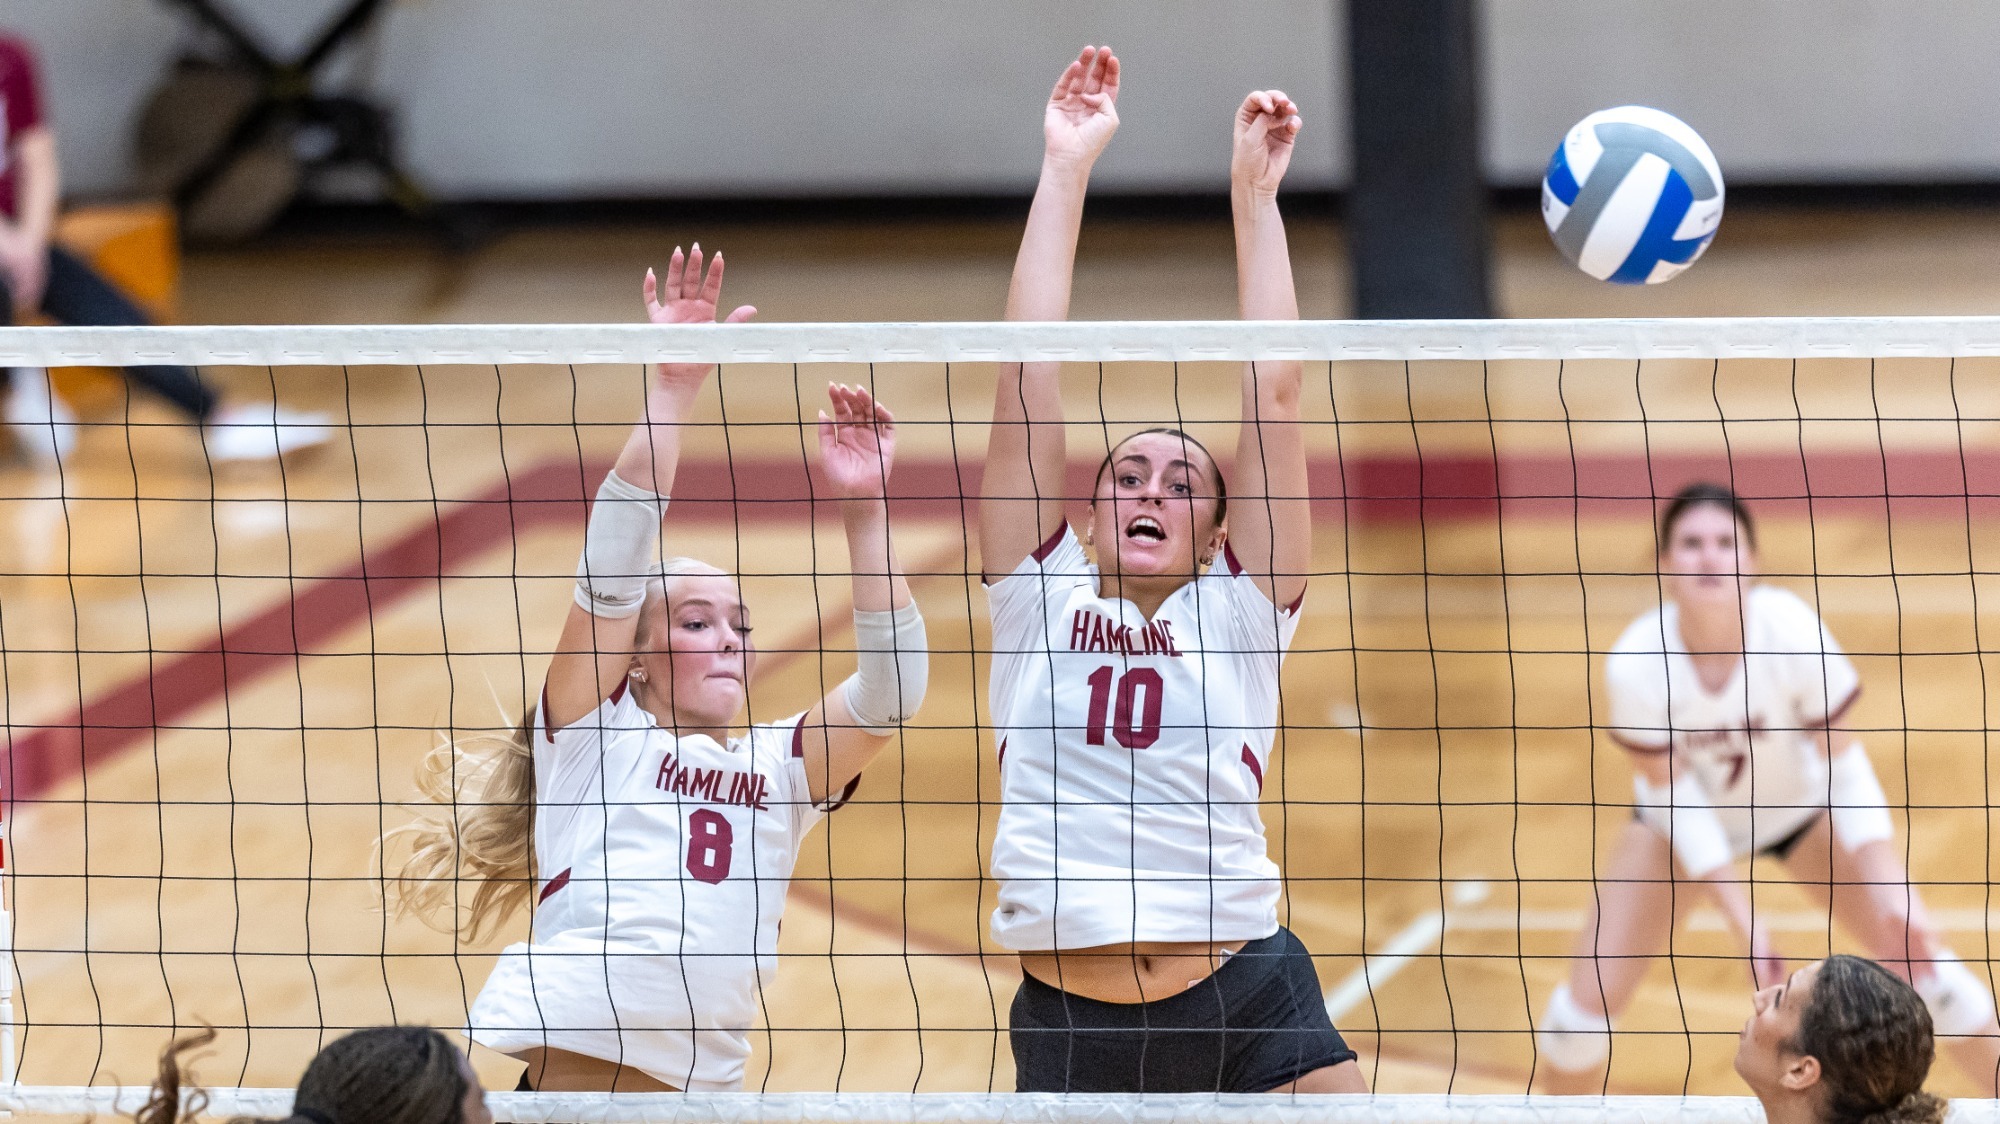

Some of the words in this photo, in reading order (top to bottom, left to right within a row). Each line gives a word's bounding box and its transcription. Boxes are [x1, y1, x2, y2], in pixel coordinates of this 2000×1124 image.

[1070, 609, 1183, 657] HAMLINE
[1086, 665, 1164, 750] 10
[655, 752, 769, 812] HAMLINE
[1716, 752, 1747, 791] 7
[685, 808, 734, 885] 8
